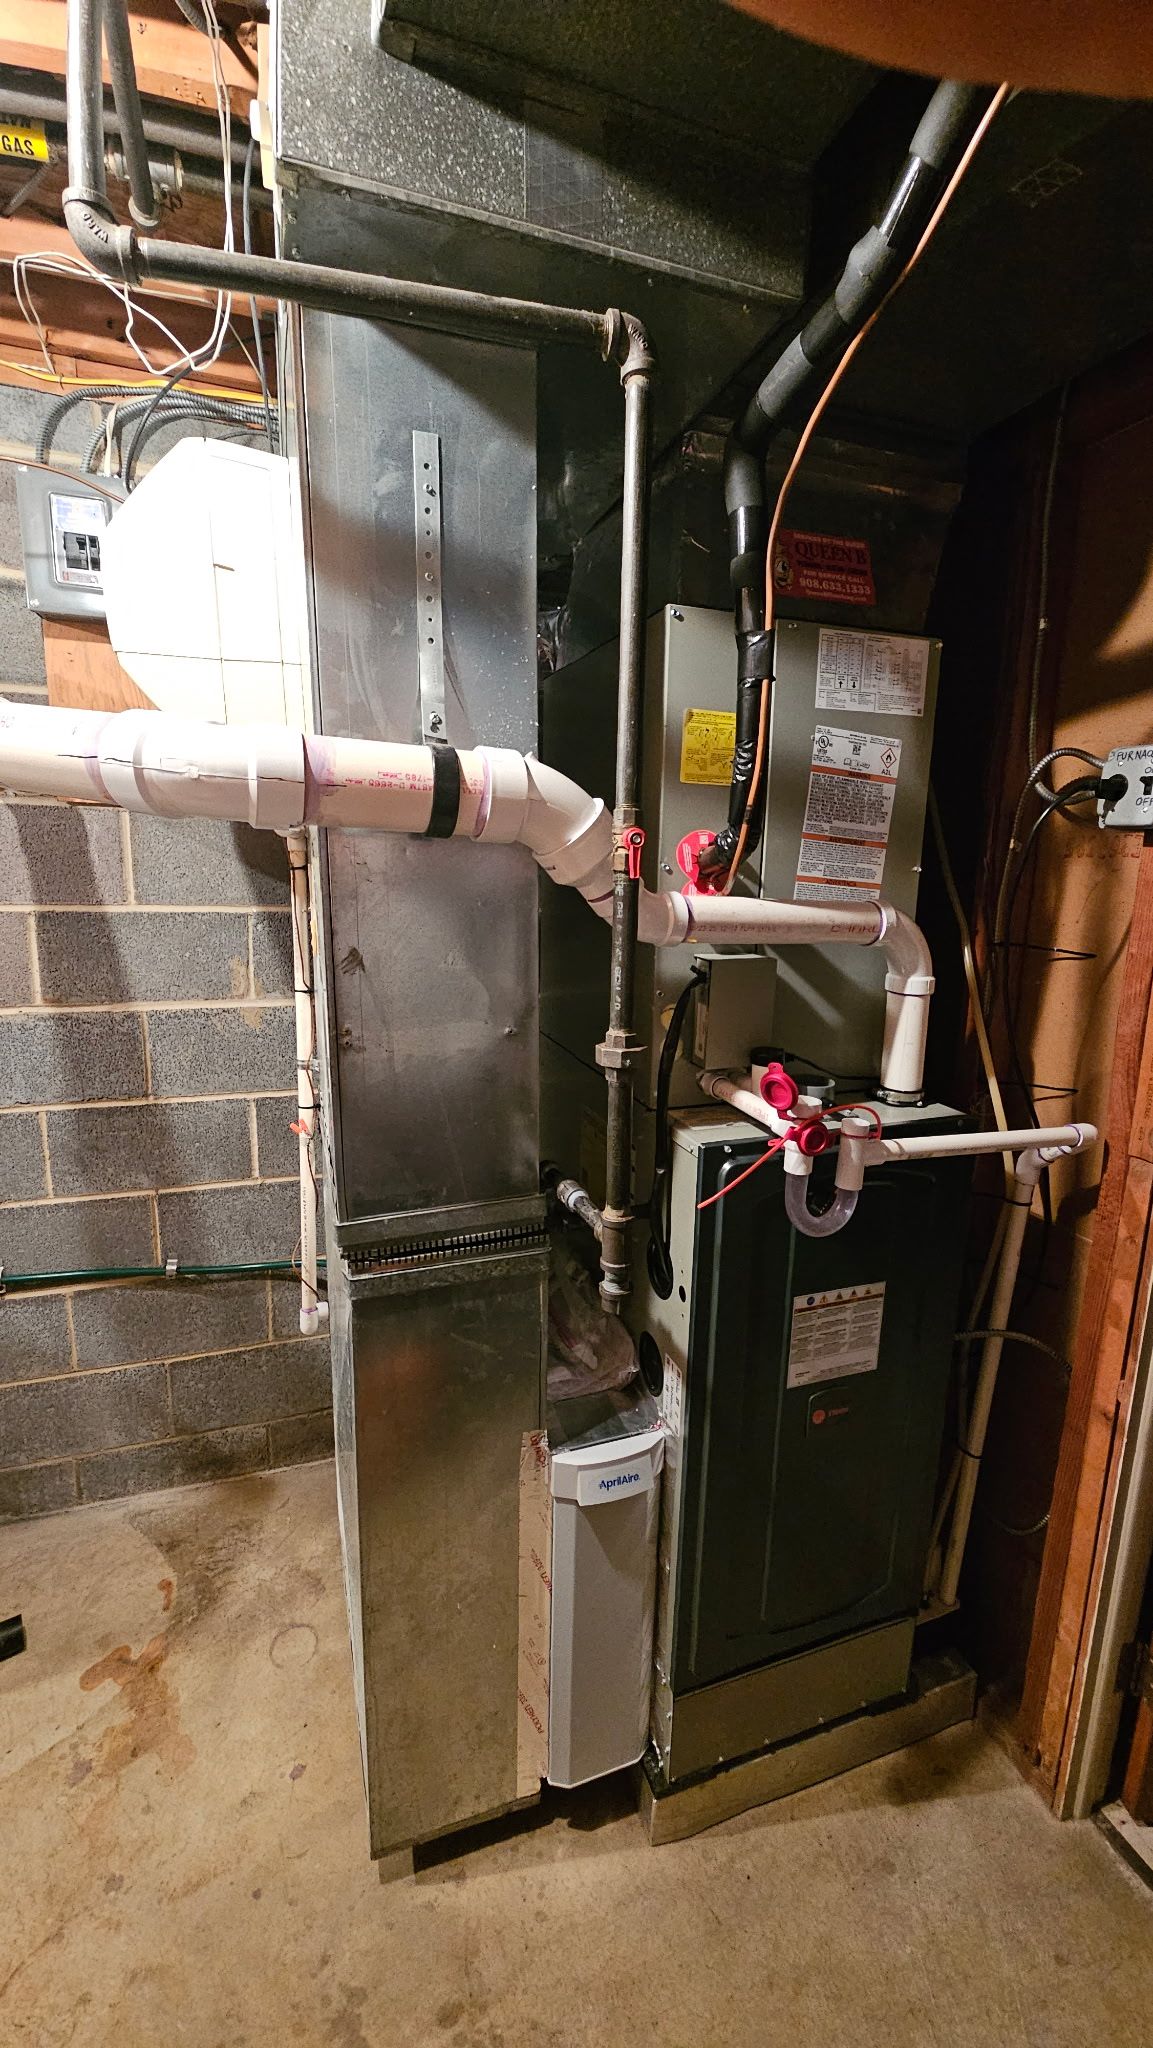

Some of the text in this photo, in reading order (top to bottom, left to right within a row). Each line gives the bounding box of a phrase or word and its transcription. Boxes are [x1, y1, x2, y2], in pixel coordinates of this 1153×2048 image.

[1, 134, 35, 155] GAS
[1116, 749, 1153, 761] FURNAC
[599, 1474, 640, 1491] AprilAire
